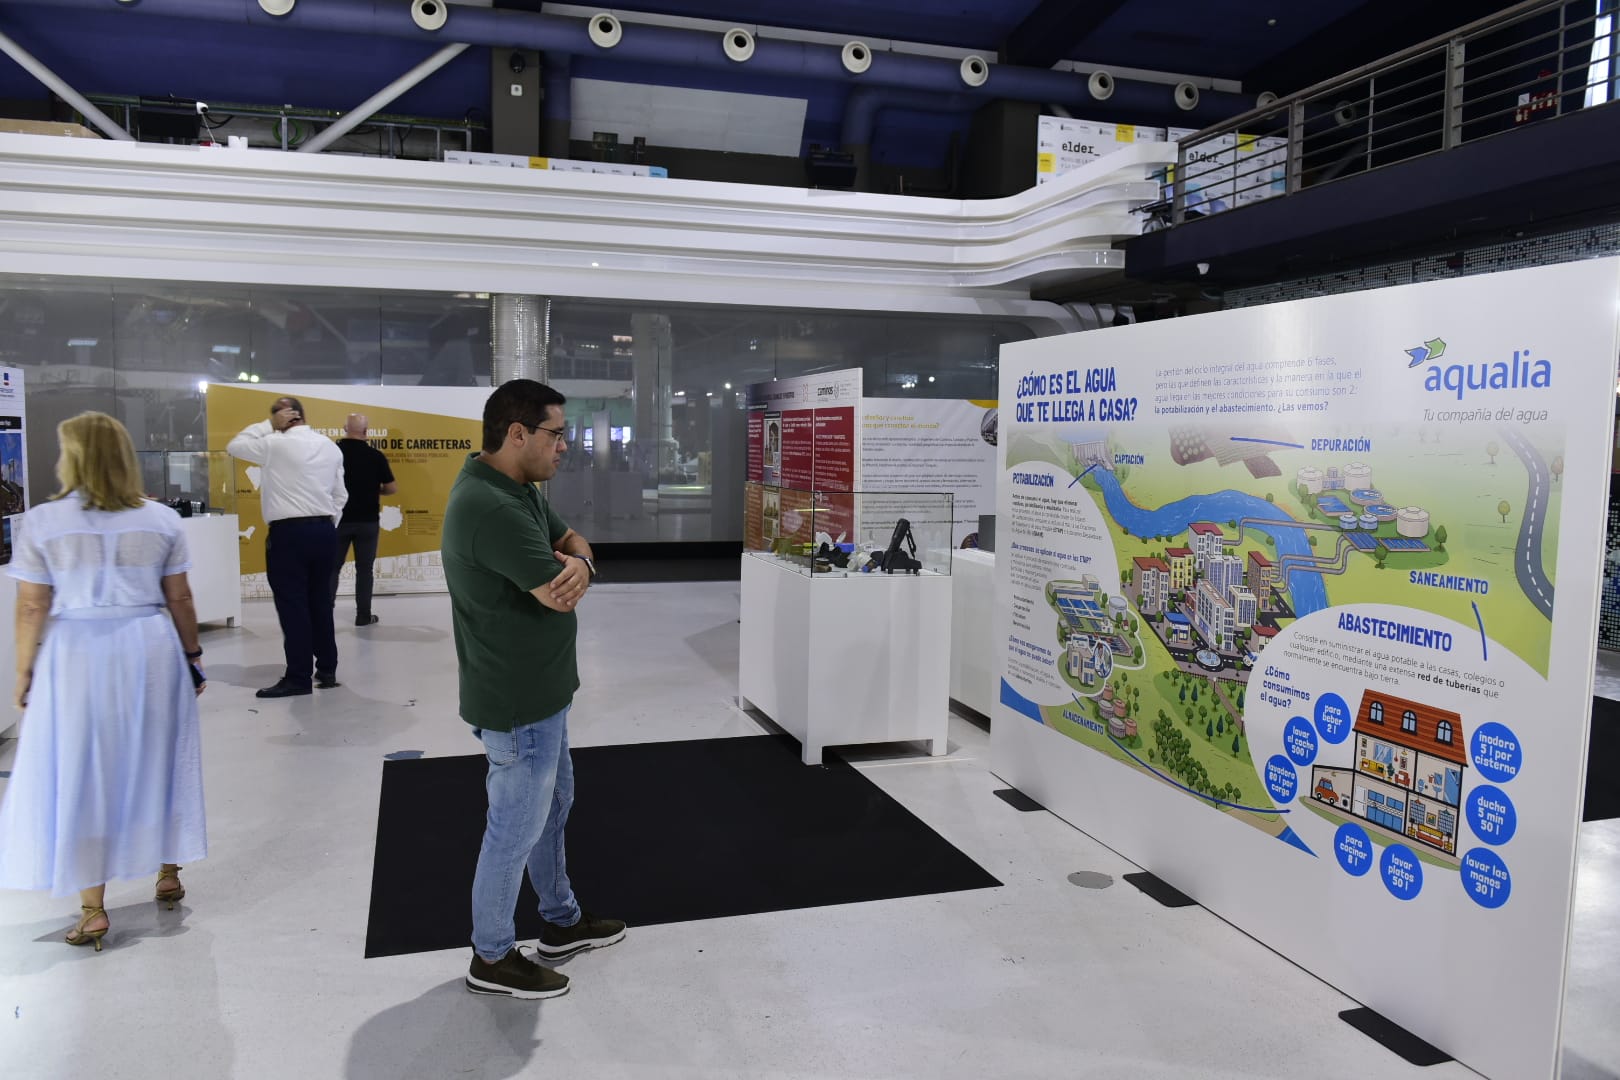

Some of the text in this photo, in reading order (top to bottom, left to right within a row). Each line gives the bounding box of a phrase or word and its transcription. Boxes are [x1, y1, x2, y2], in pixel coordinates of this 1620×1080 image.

[1016, 367, 1116, 399] ¿CÓMO ES EL AGUA
[1336, 370, 1351, 382] que
[1354, 368, 1362, 379] el
[1424, 349, 1552, 400] aqualia
[1016, 398, 1137, 422] QUE TE LLEGA A CASA?
[1161, 404, 1204, 415] potabilización
[1206, 406, 1210, 415] y
[1212, 404, 1218, 413] el
[1297, 401, 1328, 411] vemos?
[1423, 407, 1548, 424] Tu compañía del agua
[391, 439, 405, 450] DE
[407, 439, 472, 450] CARRETERAS
[1311, 436, 1371, 452] DEPURACIÓN
[1115, 453, 1144, 465] CAPTACIÓN
[1013, 473, 1054, 487] POTABILIZACIÓN
[1410, 570, 1488, 595] SANEAMIENTO
[1338, 612, 1452, 652] ABASTECIMIENTO
[1283, 650, 1322, 665] normalmente
[1331, 662, 1362, 676] encuentra
[1364, 671, 1378, 680] bajo
[1294, 632, 1318, 644] Consiste
[1329, 641, 1364, 654] suministrar
[1372, 652, 1389, 661] agua
[1391, 655, 1418, 667] potable
[1427, 662, 1436, 672] las
[1439, 667, 1460, 679] casas,
[1464, 672, 1496, 685] colegios
[1265, 666, 1290, 680] ¿Cómo
[1290, 642, 1316, 652] cualquier
[1317, 648, 1340, 660] edificio,
[1343, 654, 1372, 668] mediante
[1374, 662, 1387, 671] una
[1389, 666, 1415, 678] extensa
[1417, 673, 1430, 681] red
[1433, 676, 1443, 684] de
[1483, 689, 1499, 699] que
[1263, 680, 1310, 701] consumimos
[1260, 692, 1291, 708] el agua?
[1325, 704, 1341, 715] para
[1323, 712, 1342, 725] beber
[1293, 726, 1310, 739] lavar
[1327, 724, 1332, 733] 2
[1288, 734, 1314, 750] el coche
[1479, 731, 1515, 751] inodoro
[1292, 745, 1304, 757] 500
[1481, 744, 1487, 754] 5
[1495, 750, 1512, 761] por
[1268, 761, 1295, 780] lavadora
[1475, 754, 1516, 775] cisterna
[1271, 784, 1289, 797] carga
[1282, 779, 1293, 788] por
[1477, 796, 1506, 814] ducha
[1478, 807, 1504, 825] 5 min
[1481, 820, 1493, 832] 50
[1346, 835, 1363, 848] para
[1340, 842, 1367, 860] cocinar
[1392, 853, 1413, 870] lavar
[1466, 854, 1507, 880] lavar las
[1388, 865, 1414, 882] platos
[1392, 876, 1403, 887] 50
[1470, 870, 1501, 889] manos
[1475, 882, 1488, 895] 30
